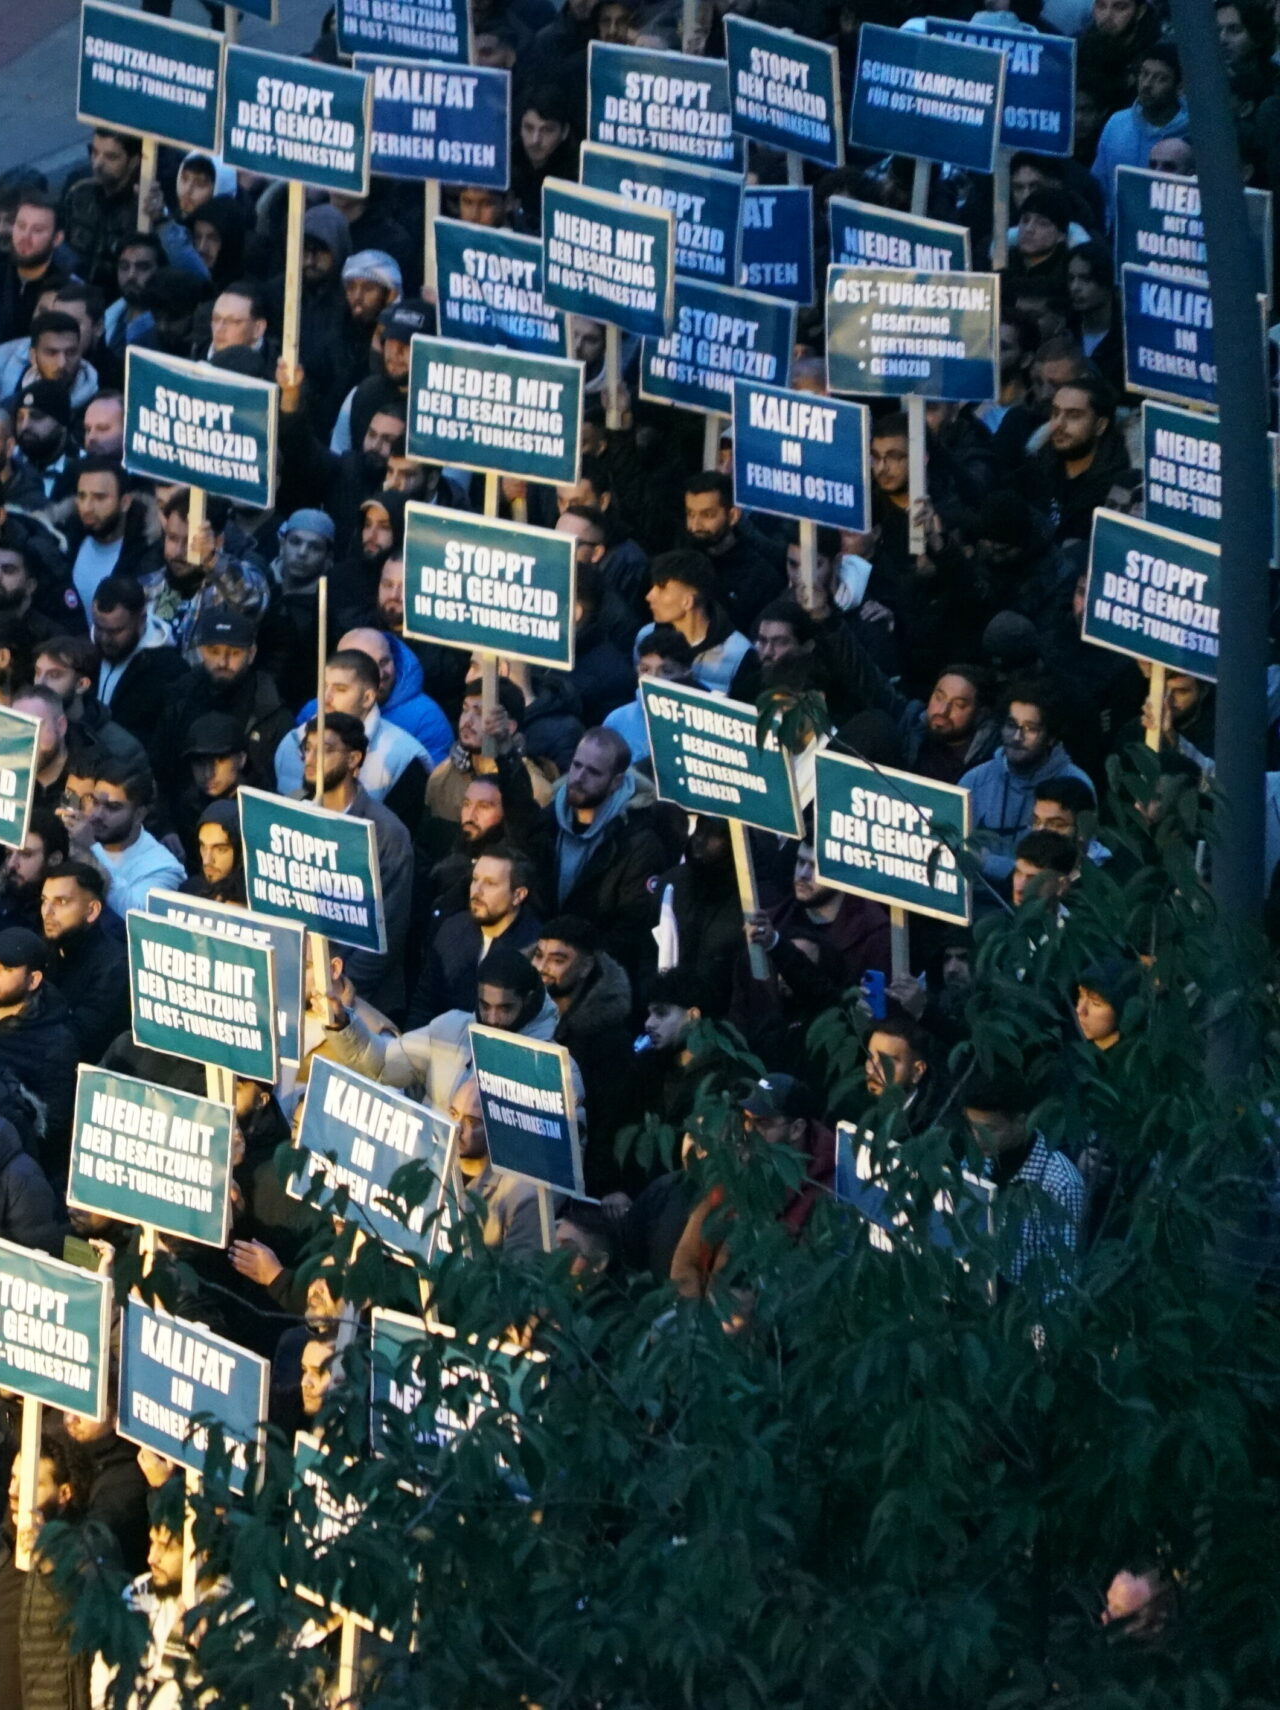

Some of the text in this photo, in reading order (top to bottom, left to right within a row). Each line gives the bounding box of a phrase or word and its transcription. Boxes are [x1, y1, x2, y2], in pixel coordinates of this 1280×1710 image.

[85, 36, 213, 88] SCHUTZKAMPAGNE
[256, 76, 332, 119] STOPPT
[373, 67, 476, 108] KALIFAT
[625, 72, 710, 110] STOPPT
[238, 101, 353, 148] DEN GENOZID
[412, 108, 435, 131] IM
[605, 96, 641, 124] DEN
[1003, 106, 1061, 134] OSTEN
[231, 128, 354, 171] IN OST-TURKESTAN
[370, 132, 495, 166] FERNEN OSTEN
[554, 210, 611, 253] NIEDER
[615, 228, 654, 265] MIT
[845, 226, 912, 267] NIEDER
[549, 238, 571, 265] DER
[574, 247, 654, 289] BESATZUNG
[679, 307, 758, 348] STOPPT
[697, 340, 775, 379] GENOZID
[427, 362, 562, 410] NIEDER MIT
[154, 386, 233, 431] STOPPT
[417, 390, 562, 434] DER BESATZUNG
[750, 393, 835, 443] KALIFAT
[138, 406, 256, 462] DEN GENOZID
[416, 414, 563, 456] IN OST-TURKESTAN
[781, 440, 801, 466] IM
[132, 432, 258, 483] IN OST-TURKESTAN
[747, 463, 853, 507] FERNEN OSTEN
[445, 541, 534, 584] STOPPT
[1125, 550, 1207, 601] STOPPT
[421, 567, 557, 617] DEN GENOZID
[1094, 599, 1112, 621] IN
[1103, 572, 1139, 607] DEN
[415, 594, 559, 640] IN OST-TURKESTAN
[681, 733, 748, 768] BESATZUNG
[683, 755, 767, 794] VERTREIBUNG
[687, 775, 740, 804] GENOZID
[830, 811, 867, 846] DEN
[850, 787, 932, 836] STOPPT
[269, 823, 338, 870] STOPPT
[825, 838, 840, 861] IN
[256, 849, 364, 903] DEN GENOZID
[254, 877, 266, 899] IN
[268, 881, 367, 927] OST-TURKESTAN
[141, 939, 255, 998] NIEDER MIT
[138, 969, 165, 1000] DER
[168, 977, 256, 1025] BESATZUNG
[138, 996, 152, 1020] IN
[154, 1002, 261, 1051] OST-TURKESTAN
[91, 1091, 213, 1157] NIEDER MIT
[324, 1076, 422, 1156] KALIFAT
[80, 1122, 212, 1186] DER BESATZUNG
[351, 1137, 374, 1171] IM
[78, 1152, 211, 1212] IN OST-TURKESTAN
[4, 1309, 88, 1364] GENOZID
[141, 1316, 234, 1394] KALIFAT
[171, 1376, 193, 1410] IM
